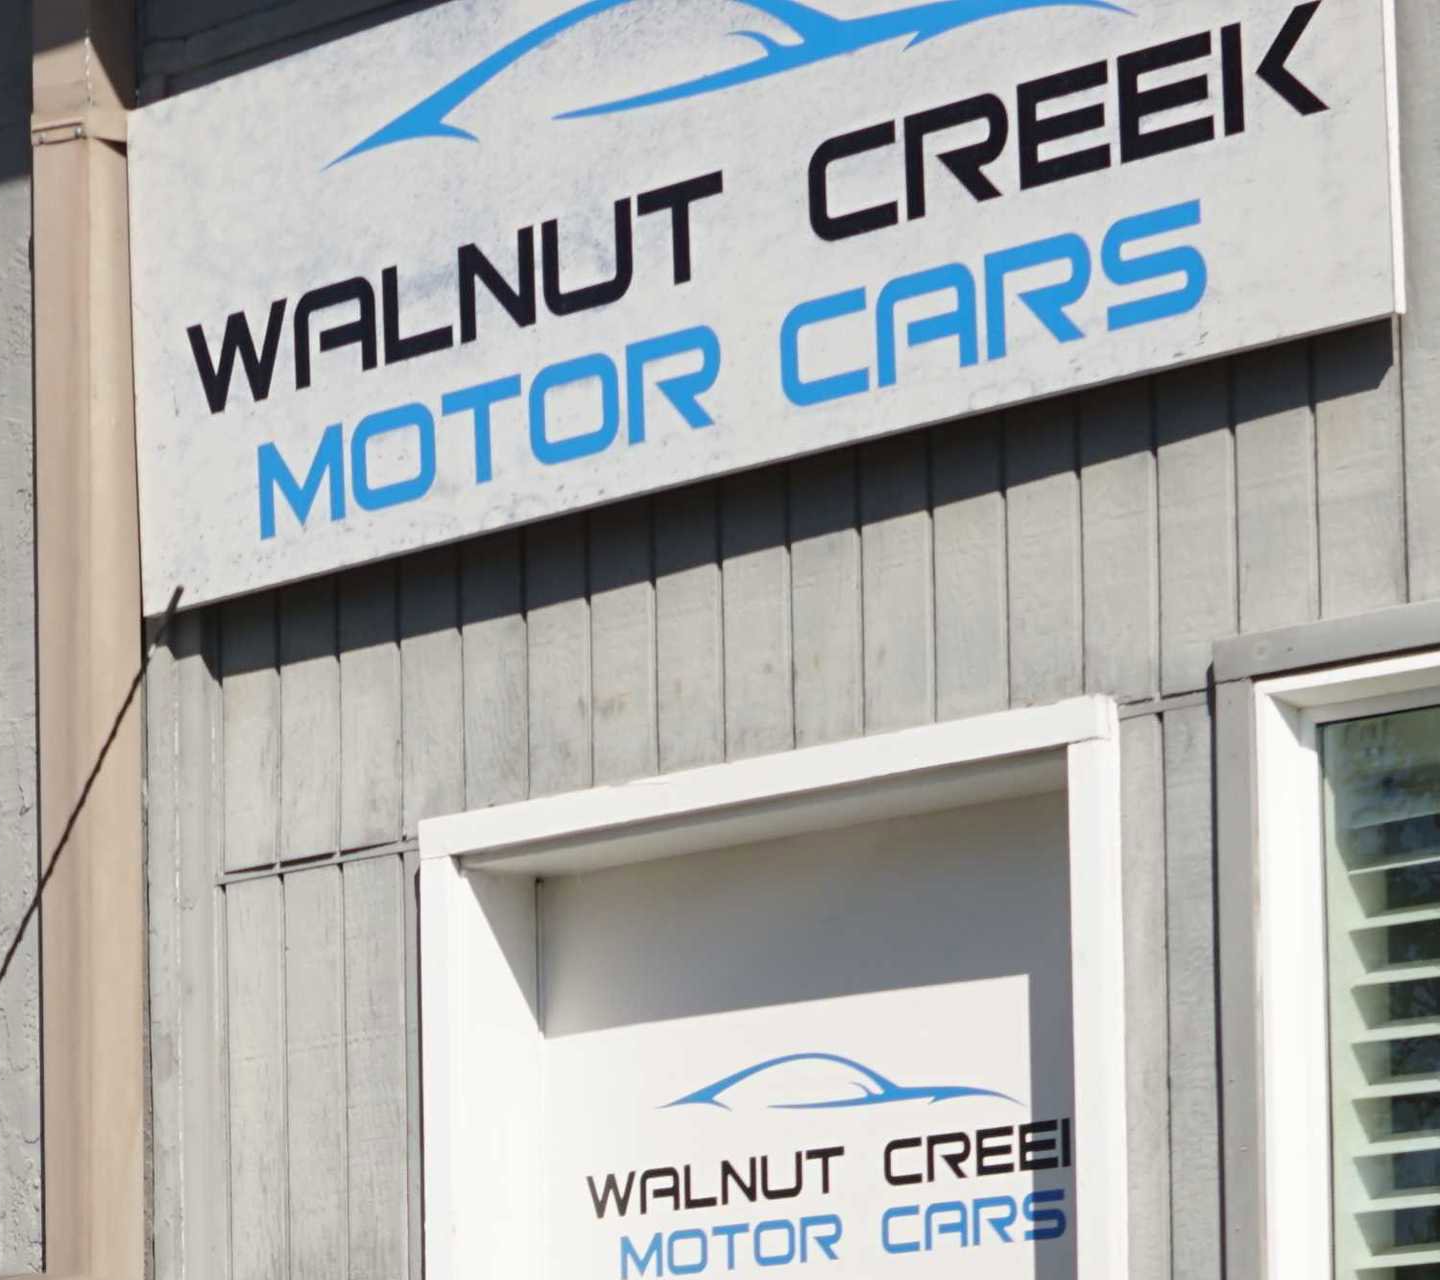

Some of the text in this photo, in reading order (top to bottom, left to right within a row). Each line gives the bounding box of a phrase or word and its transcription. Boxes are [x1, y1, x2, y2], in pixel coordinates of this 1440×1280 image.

[187, 0, 1328, 414] WALNUT CREEK
[258, 200, 1207, 540] MOTOR CARS
[586, 1117, 1072, 1219] WALNUT CREE
[619, 1188, 1067, 1280] MOTOR CARS
